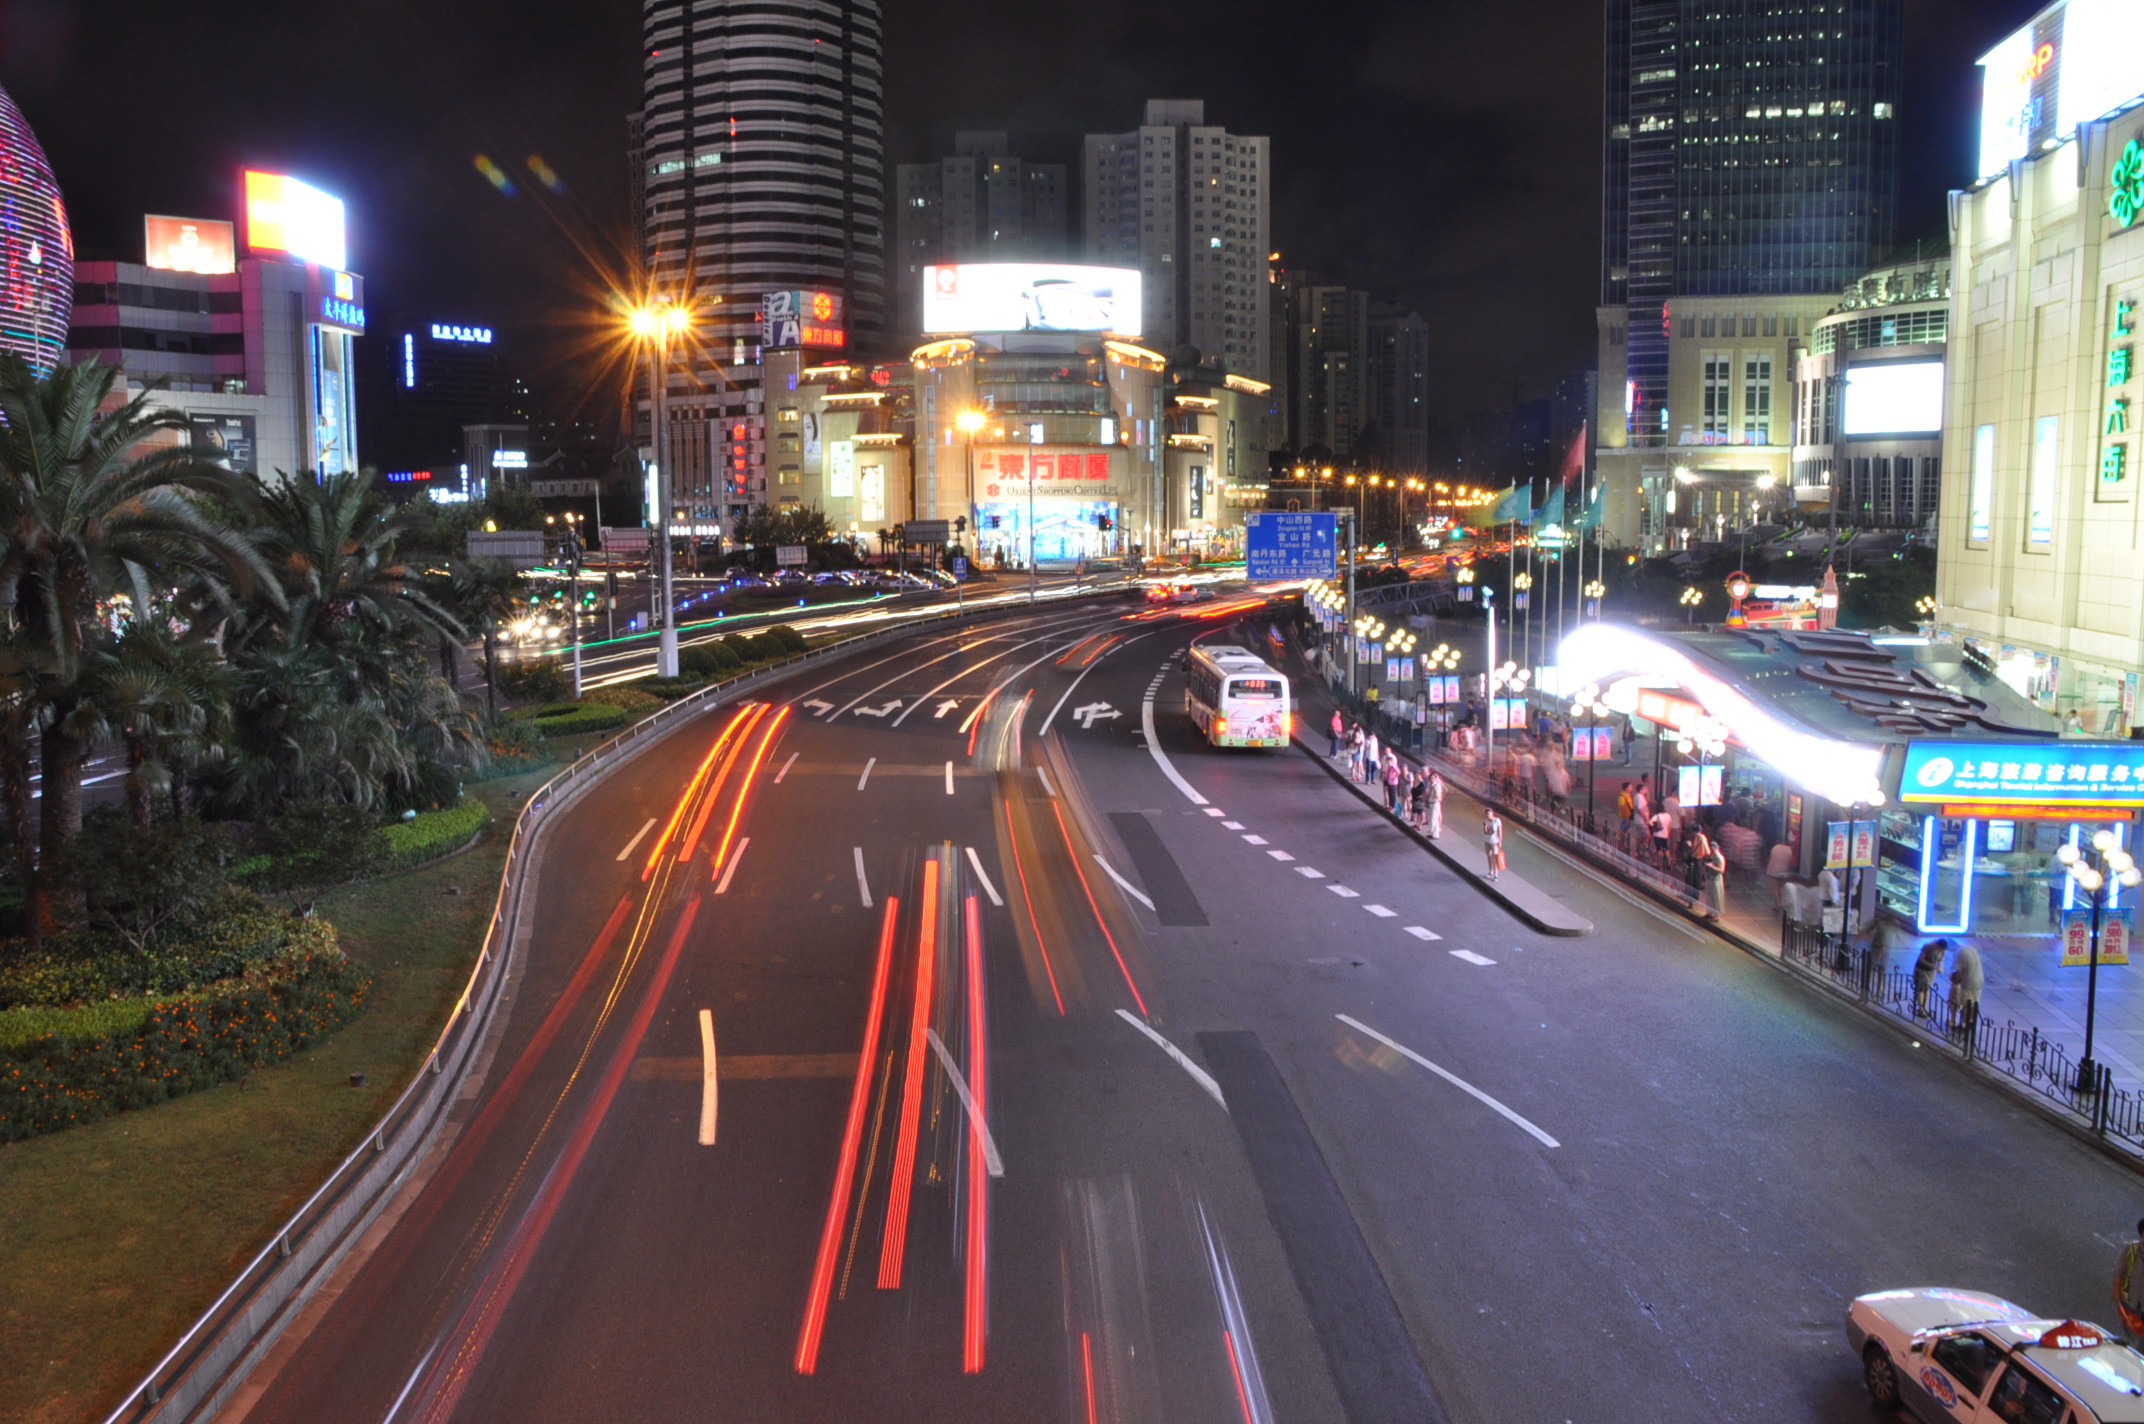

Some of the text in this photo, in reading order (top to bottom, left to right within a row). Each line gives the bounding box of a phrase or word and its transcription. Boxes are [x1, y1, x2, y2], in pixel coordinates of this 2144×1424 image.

[2102, 300, 2131, 482] 上海六百
[1277, 515, 1312, 525] 中山西路
[1251, 549, 1287, 558] 南丹东路
[1303, 549, 1331, 558] 广元路
[1954, 780, 1998, 790] Shanghai
[2034, 782, 2089, 791] Information
